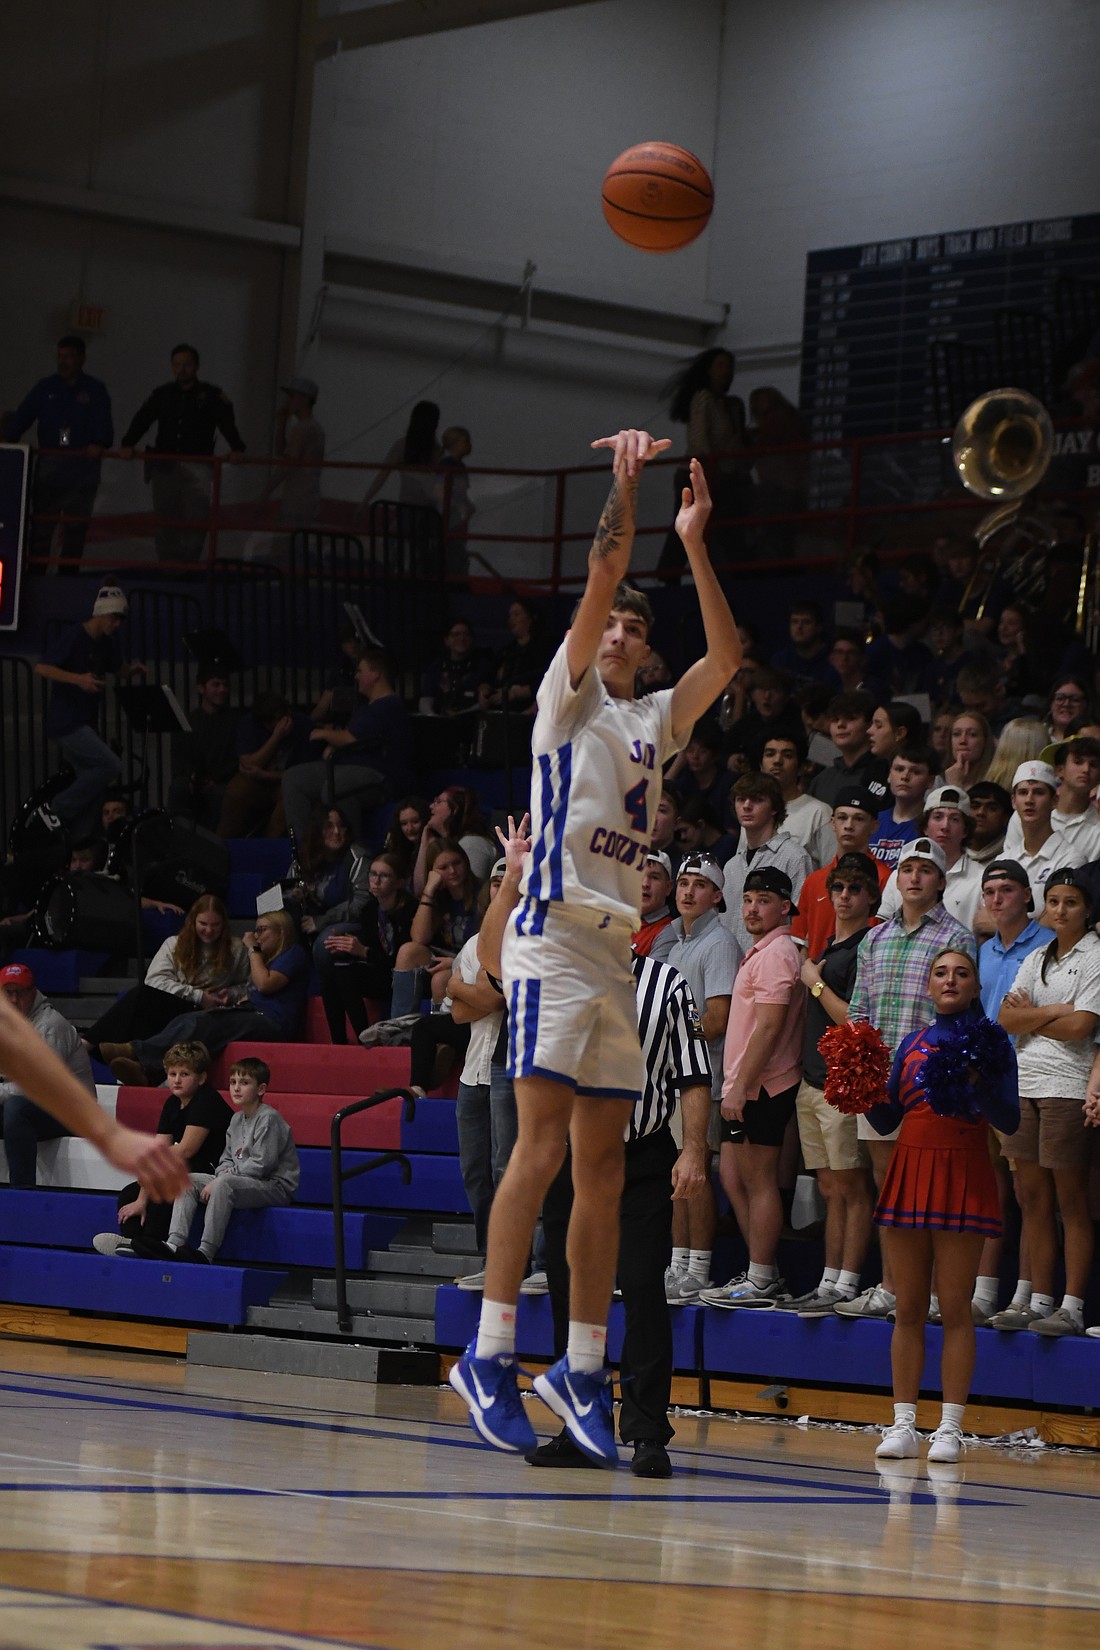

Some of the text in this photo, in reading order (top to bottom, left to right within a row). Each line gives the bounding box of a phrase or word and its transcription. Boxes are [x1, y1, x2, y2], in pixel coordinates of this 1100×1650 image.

[79, 304, 103, 328] EXIT
[1053, 430, 1094, 456] JAY
[625, 776, 648, 833] 4
[589, 827, 649, 872] COUNT
